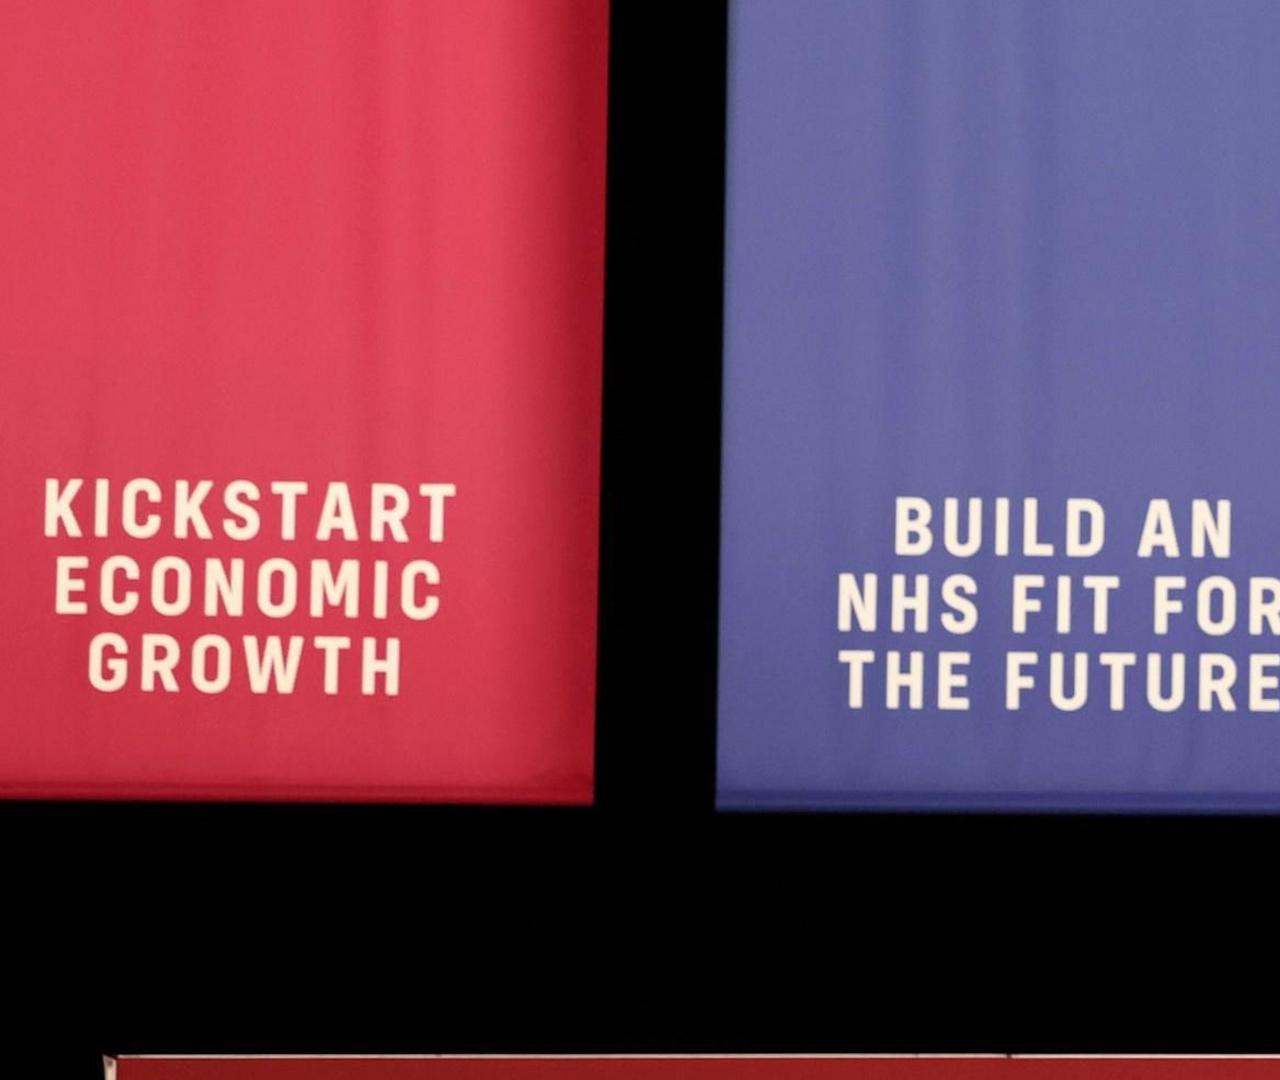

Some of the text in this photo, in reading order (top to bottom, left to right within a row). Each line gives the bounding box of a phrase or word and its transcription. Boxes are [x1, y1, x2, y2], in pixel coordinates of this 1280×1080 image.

[44, 477, 457, 543] KICKSTART
[895, 496, 1231, 559] BUILD AN
[55, 555, 440, 621] ECONOMIC
[837, 572, 978, 635] NHS
[1012, 574, 1120, 634] FIT
[88, 632, 400, 696] GROWTH
[838, 649, 971, 711] THE
